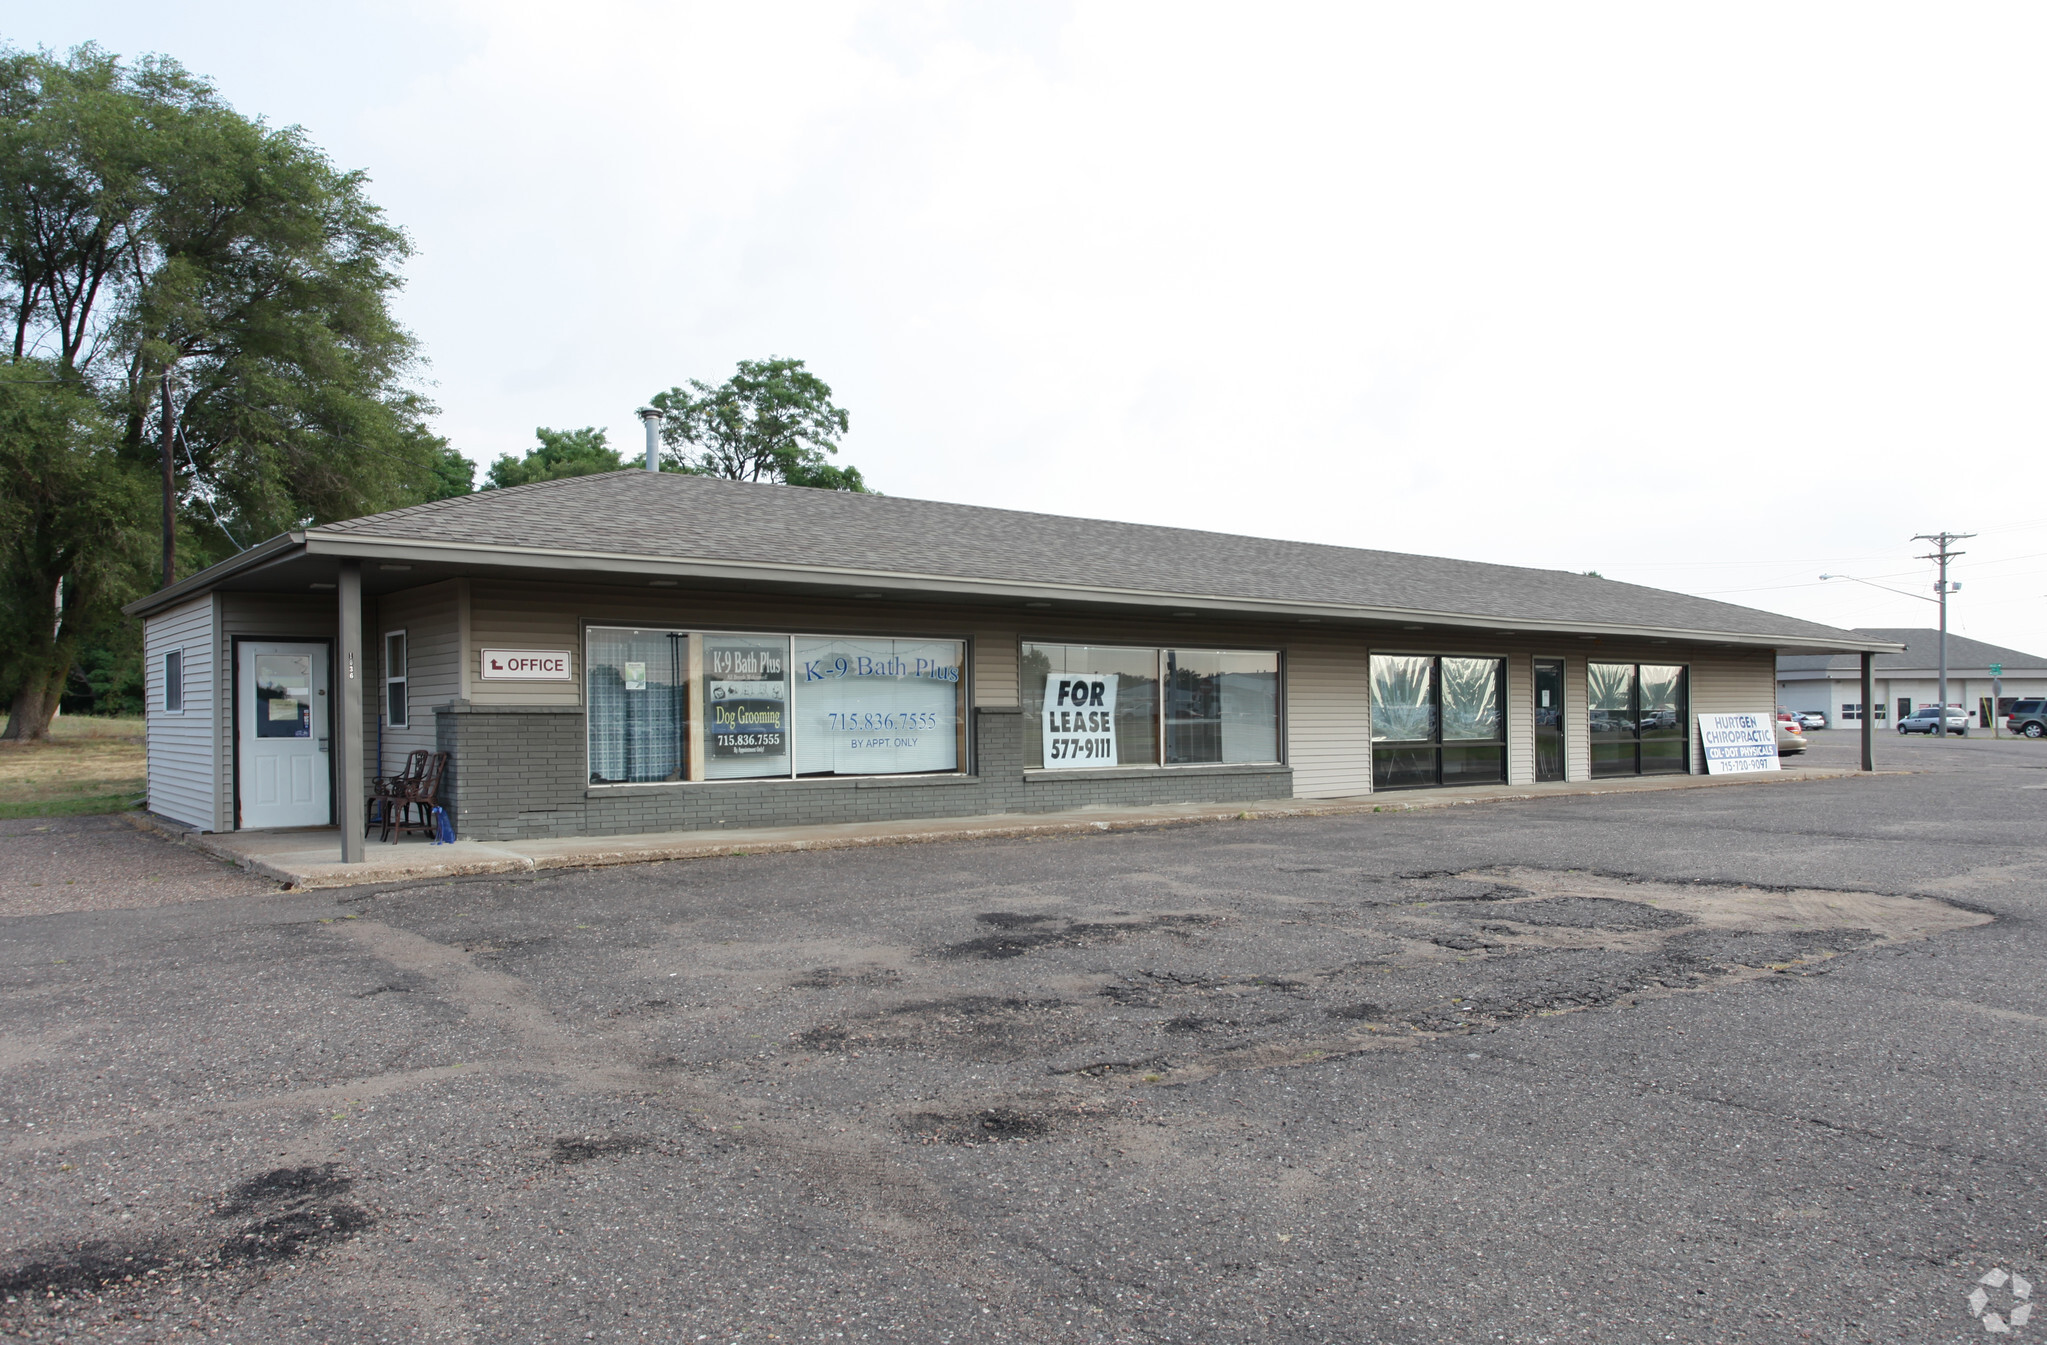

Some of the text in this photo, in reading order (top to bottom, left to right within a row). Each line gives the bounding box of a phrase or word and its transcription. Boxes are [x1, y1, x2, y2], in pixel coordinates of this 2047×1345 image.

[508, 658, 564, 671] OFFICE
[734, 651, 757, 673] Bath
[760, 651, 781, 673] Plus
[804, 656, 959, 682] K-9 Bath Plus
[1057, 680, 1105, 707] FOR
[716, 706, 780, 729] Dog Grooming
[828, 713, 936, 731] 715.836.7555
[1049, 711, 1111, 733] LEASE
[1714, 716, 1758, 729] HURTGEN
[718, 733, 780, 746] 715.836.7555
[851, 738, 918, 748] BY APPT. ONLY
[1706, 729, 1771, 744] CHIROPRACTIC
[1050, 738, 1111, 759] 577-9111
[1740, 745, 1774, 757] PHYSICALS
[1720, 758, 1769, 772] 715-720-9097
